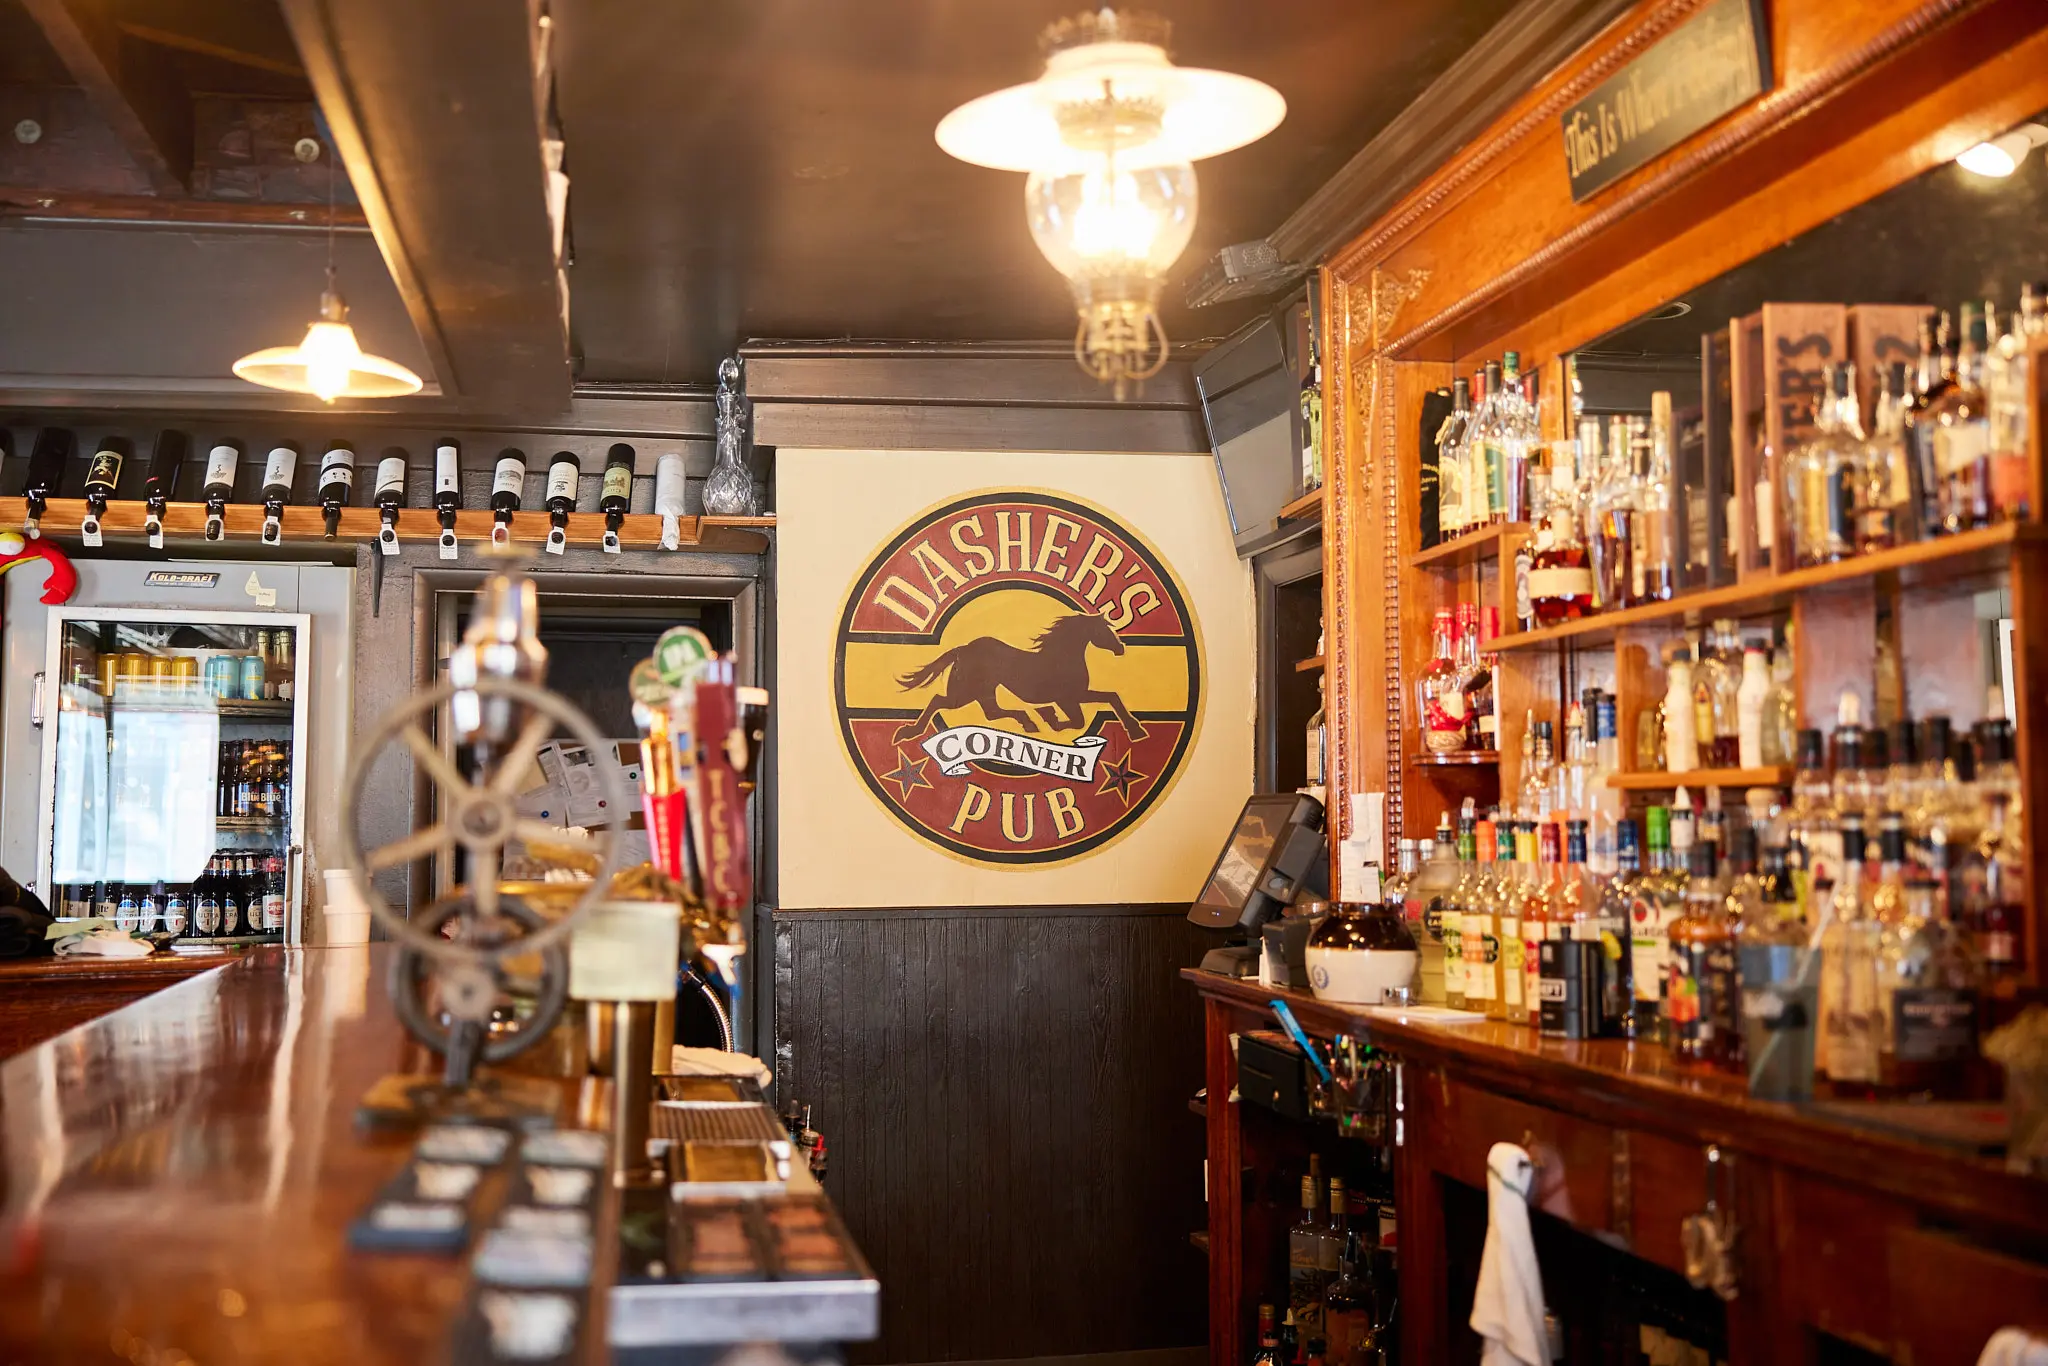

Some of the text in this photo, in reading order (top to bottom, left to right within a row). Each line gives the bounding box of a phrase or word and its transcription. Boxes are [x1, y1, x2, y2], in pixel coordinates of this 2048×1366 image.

[872, 511, 1163, 632] DASHER'S
[934, 731, 1088, 778] CORNER
[949, 782, 1086, 842] PUB
